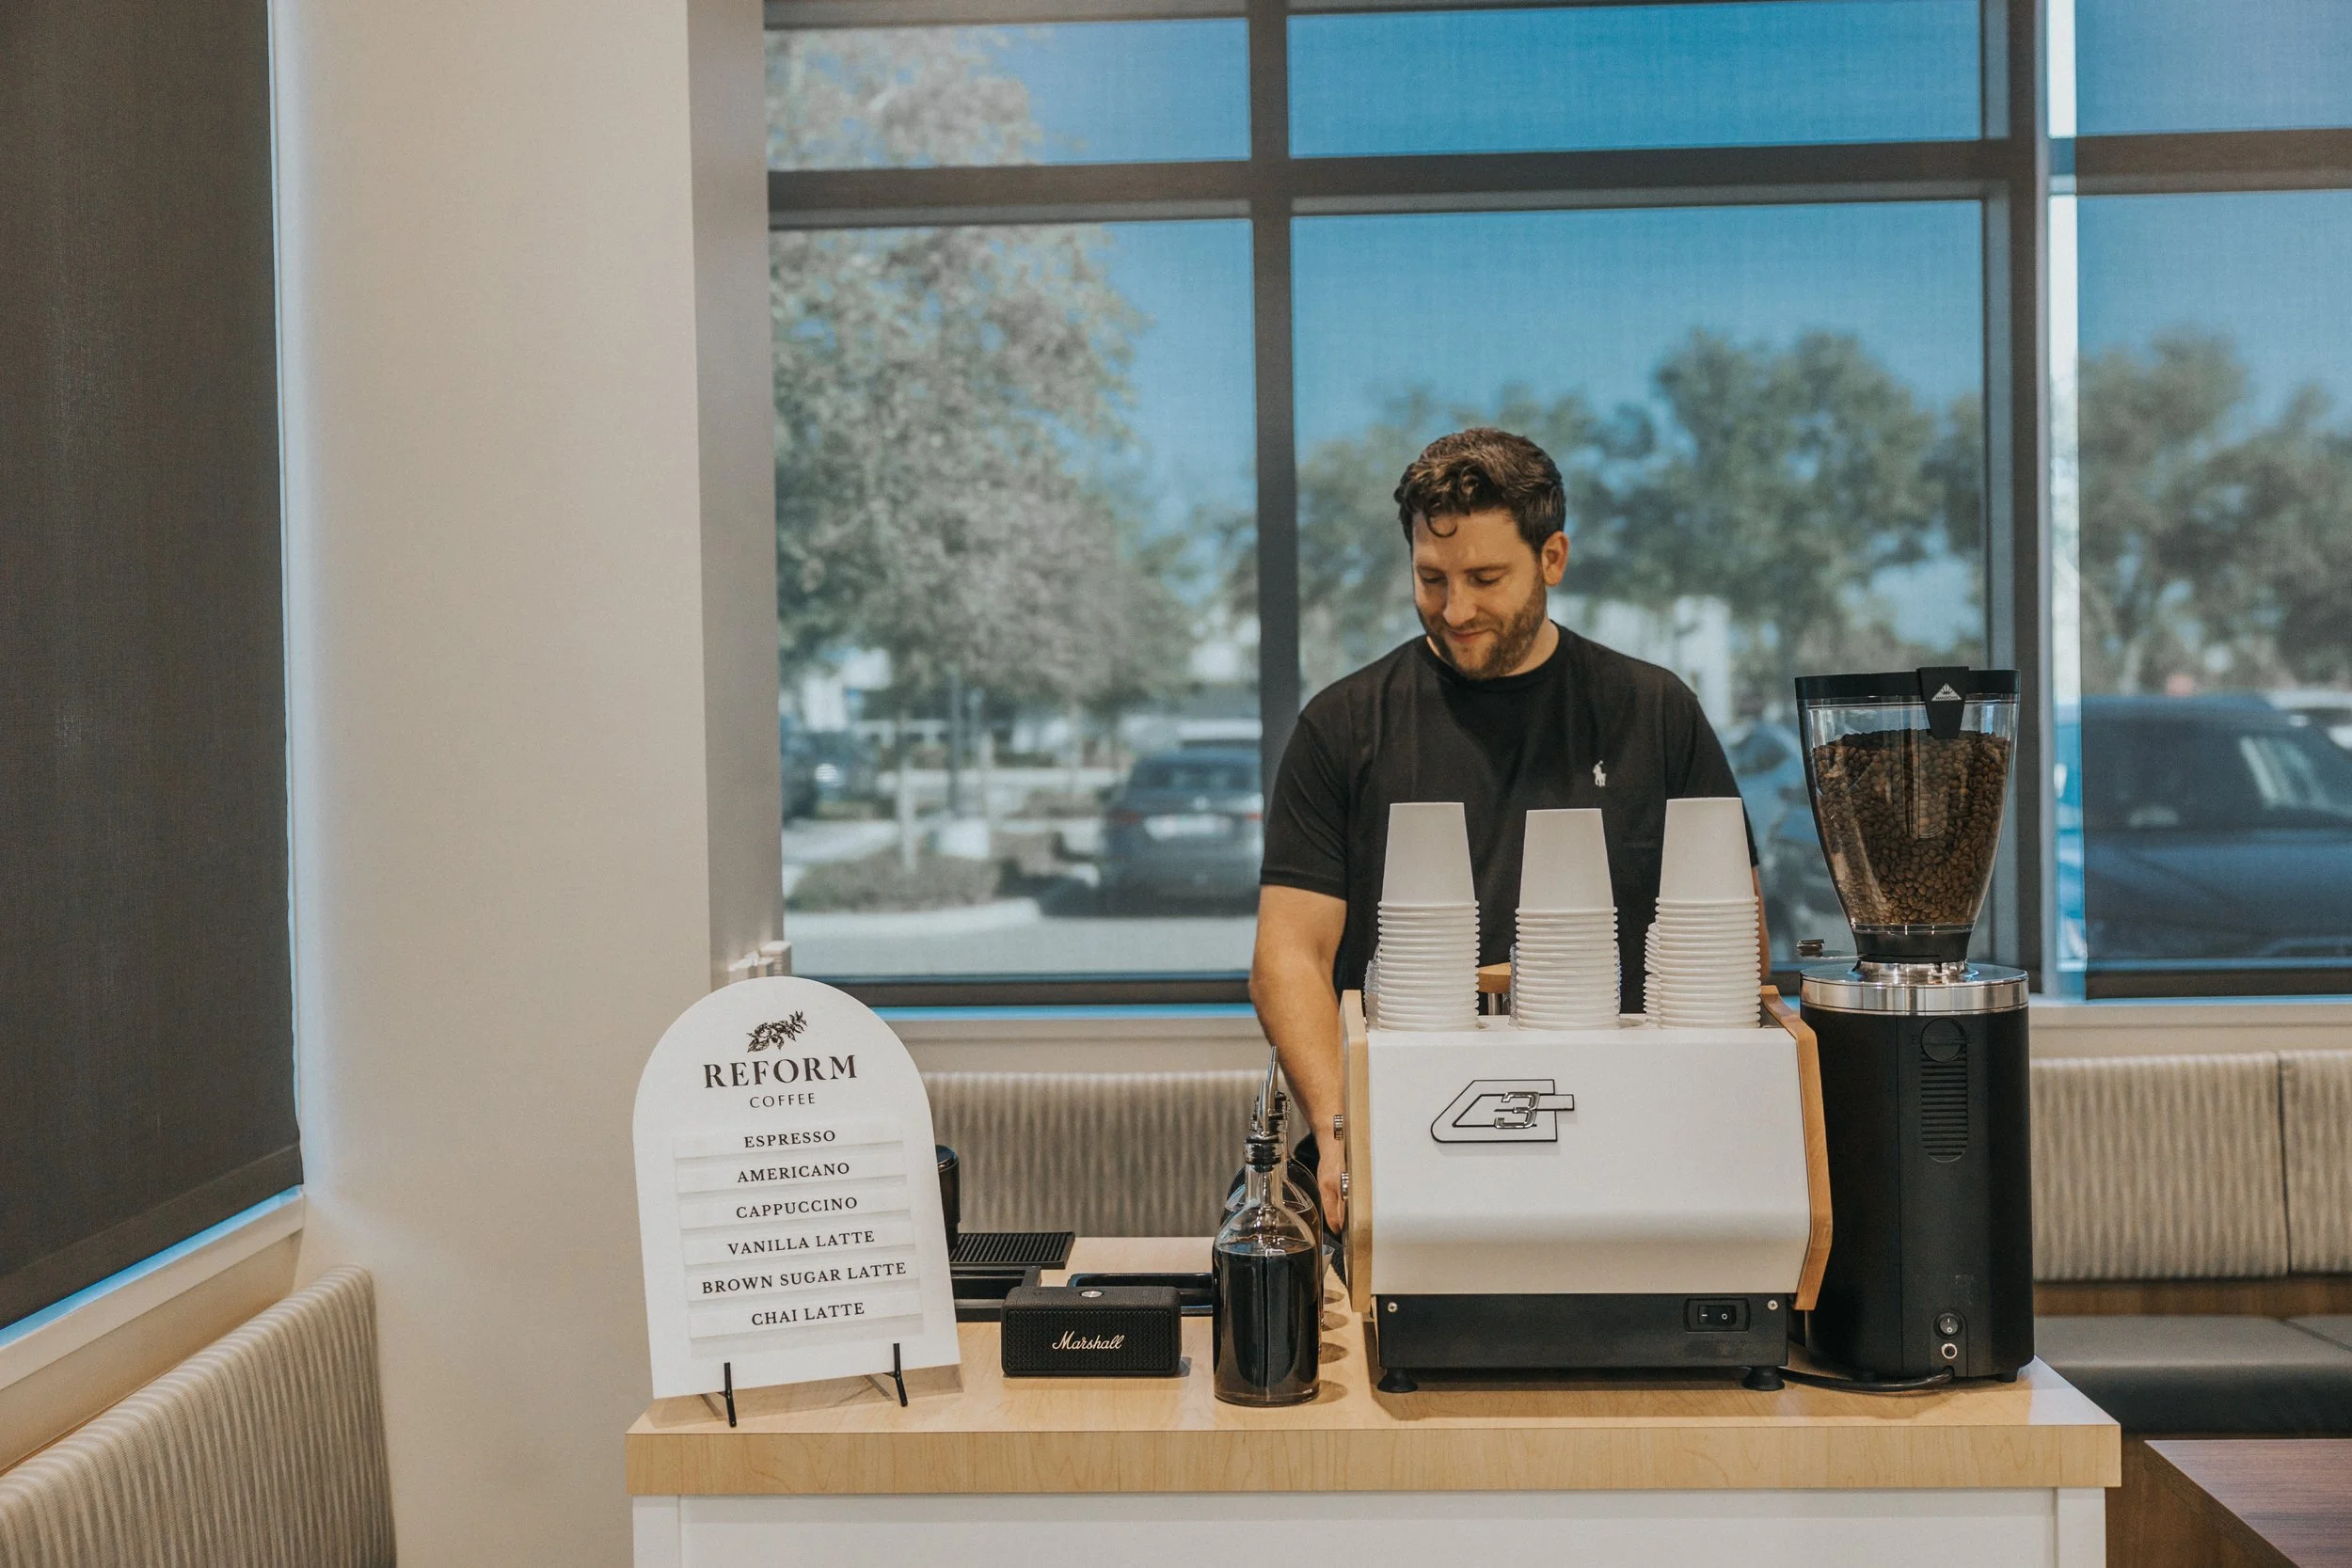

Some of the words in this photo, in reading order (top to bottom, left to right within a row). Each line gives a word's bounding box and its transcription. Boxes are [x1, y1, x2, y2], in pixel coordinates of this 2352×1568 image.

[704, 1055, 857, 1088] REFORM
[749, 1092, 816, 1109] COFFEE
[743, 1130, 836, 1148] ESPRESSO
[737, 1162, 850, 1183] AMERICANO
[736, 1196, 858, 1219] CAPPUCCINO
[726, 1236, 810, 1256] VANILLA
[815, 1230, 875, 1248] LATTE
[702, 1275, 773, 1294] BROWN
[780, 1268, 842, 1287] SUGAR
[847, 1261, 907, 1280] LATTE
[751, 1308, 798, 1326] CHAI
[803, 1302, 866, 1321] LATTE
[1052, 1331, 1124, 1349] Marshall
